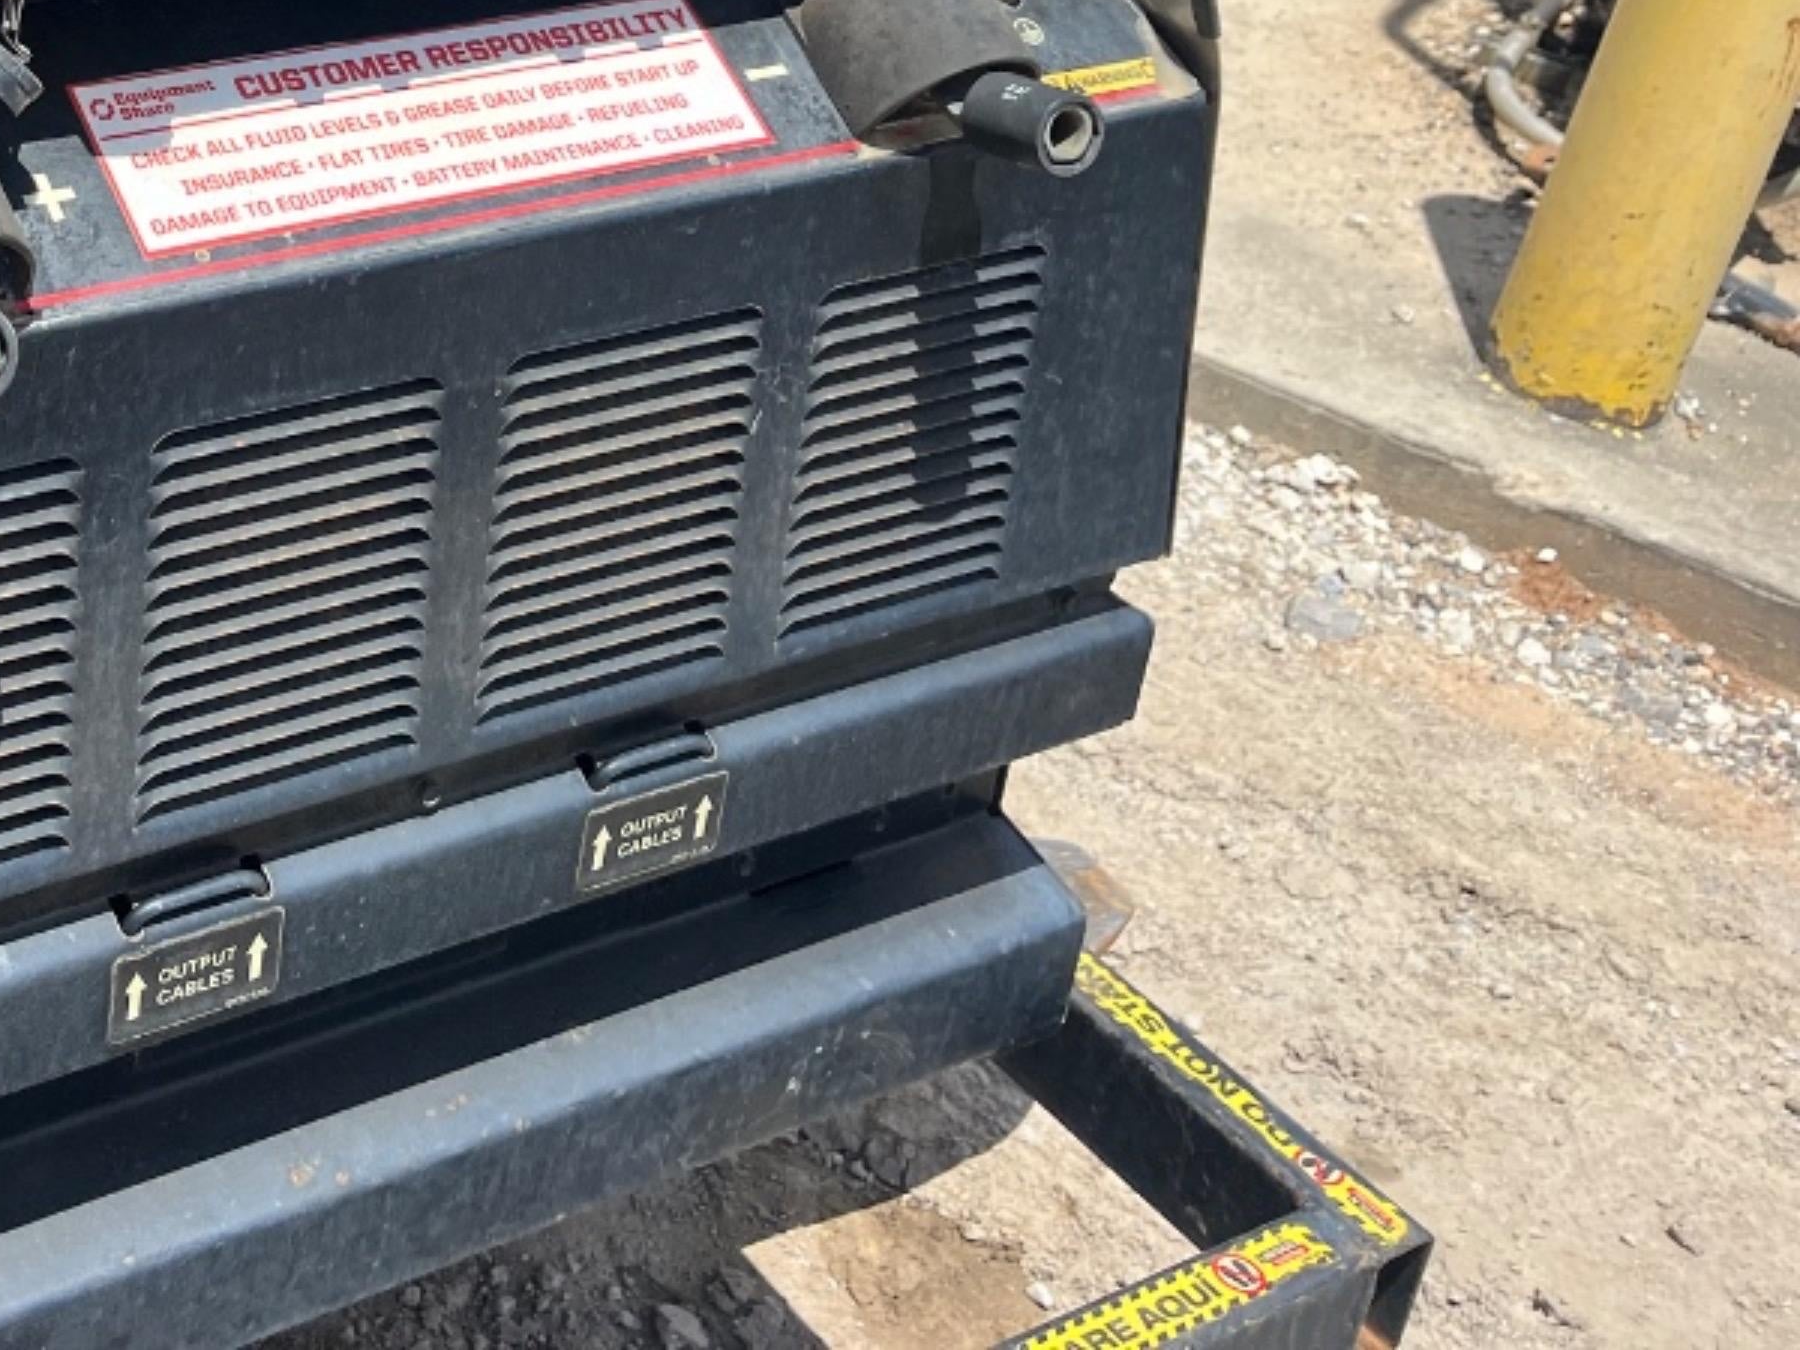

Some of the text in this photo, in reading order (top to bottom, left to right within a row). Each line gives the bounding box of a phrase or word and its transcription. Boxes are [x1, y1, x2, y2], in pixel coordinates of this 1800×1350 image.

[234, 8, 688, 100] CUSTOMER RESPONSIBILITY
[112, 78, 216, 107] Equipment
[118, 102, 175, 122] Share
[130, 141, 201, 170] CHECK
[207, 136, 245, 158] ALL
[248, 125, 308, 150] FLUID
[309, 112, 383, 140] LEVELS
[403, 95, 480, 124] GREASE
[483, 81, 537, 111] DAILY
[539, 72, 613, 102] BEFORE
[615, 65, 671, 91] START
[673, 59, 700, 80] UP
[178, 92, 690, 196] INSURANCE FLAT TIRES TIRE DAMAGE REFUELING
[149, 114, 745, 237] DAMAGE TO EQUIPMENT BATTERY MAINTENANCE CLEANING
[616, 825, 683, 859] CABLES
[619, 804, 689, 838] OUTPUT
[157, 945, 239, 985] OUTPUT
[155, 968, 235, 1006] CABLES
[1161, 1039, 1241, 1098] NOT
[1240, 1101, 1294, 1148] DO
